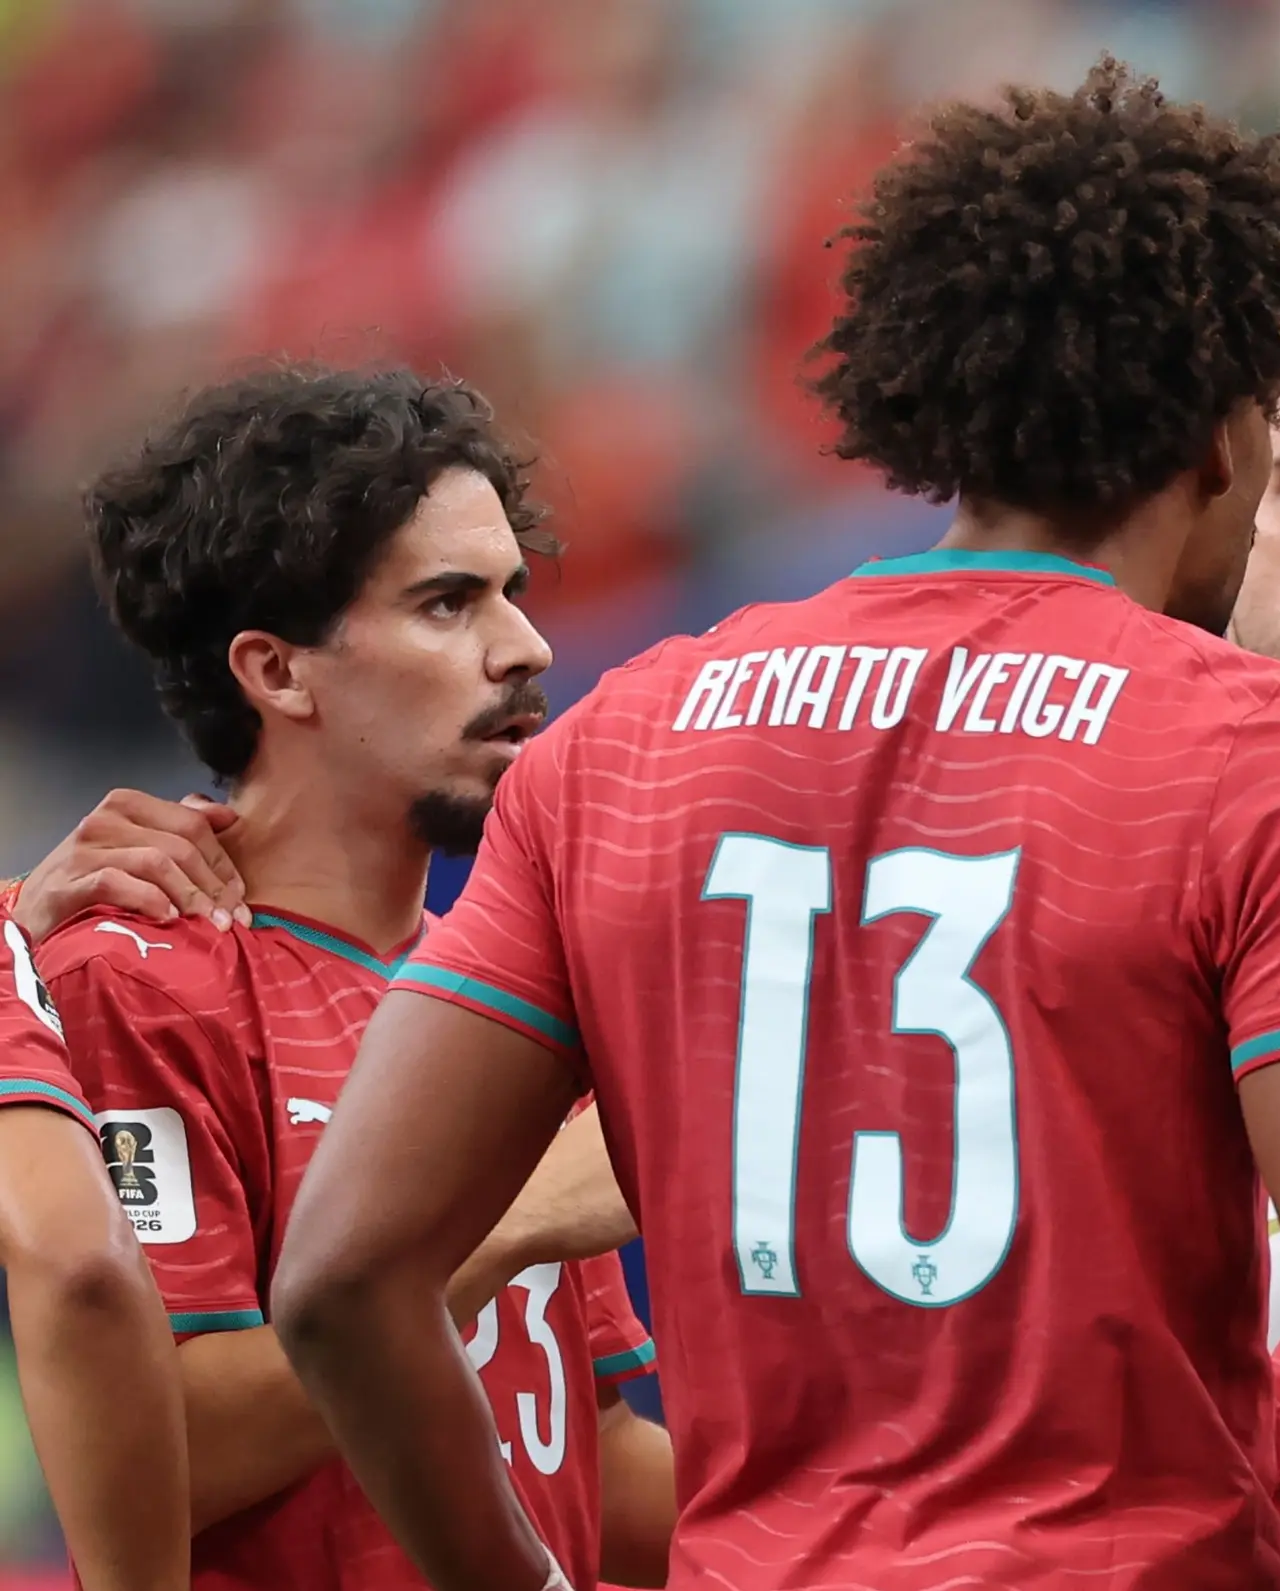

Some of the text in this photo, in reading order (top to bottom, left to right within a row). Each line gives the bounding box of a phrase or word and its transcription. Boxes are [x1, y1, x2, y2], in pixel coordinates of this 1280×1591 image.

[672, 645, 1129, 745] RENATO VEIGA
[701, 832, 1021, 1307] 13
[118, 1189, 144, 1199] FIFA
[142, 1209, 161, 1217] CUP
